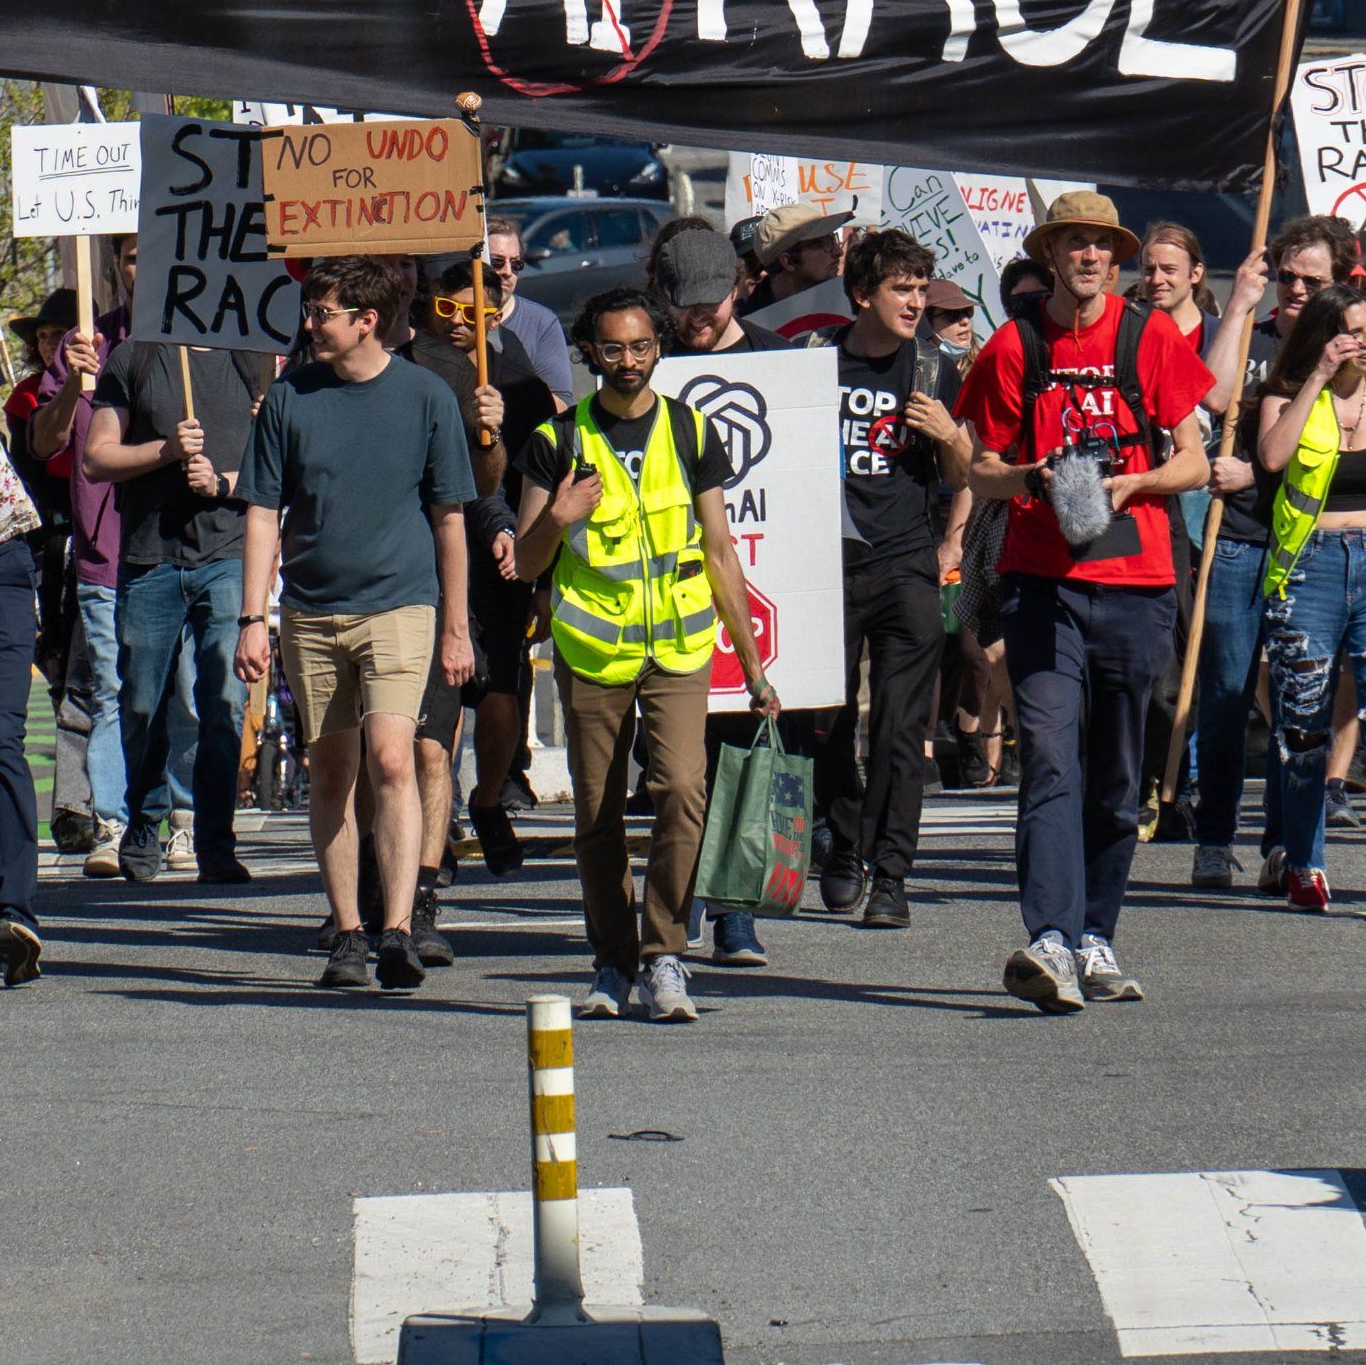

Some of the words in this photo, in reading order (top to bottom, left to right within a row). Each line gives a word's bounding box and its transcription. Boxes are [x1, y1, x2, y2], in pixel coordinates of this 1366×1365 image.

[34, 145, 87, 173] TIME
[96, 143, 131, 166] OUT
[277, 133, 331, 170] NO
[366, 126, 449, 162] UNDO
[332, 167, 377, 189] FOR
[888, 166, 944, 212] Can
[18, 195, 42, 221] Let
[55, 189, 100, 222] U.S.
[279, 190, 468, 236] EXTINCTION
[155, 200, 269, 262] THE
[161, 264, 295, 346] RAC
[838, 386, 896, 416] TOP
[1081, 391, 1115, 416] AI
